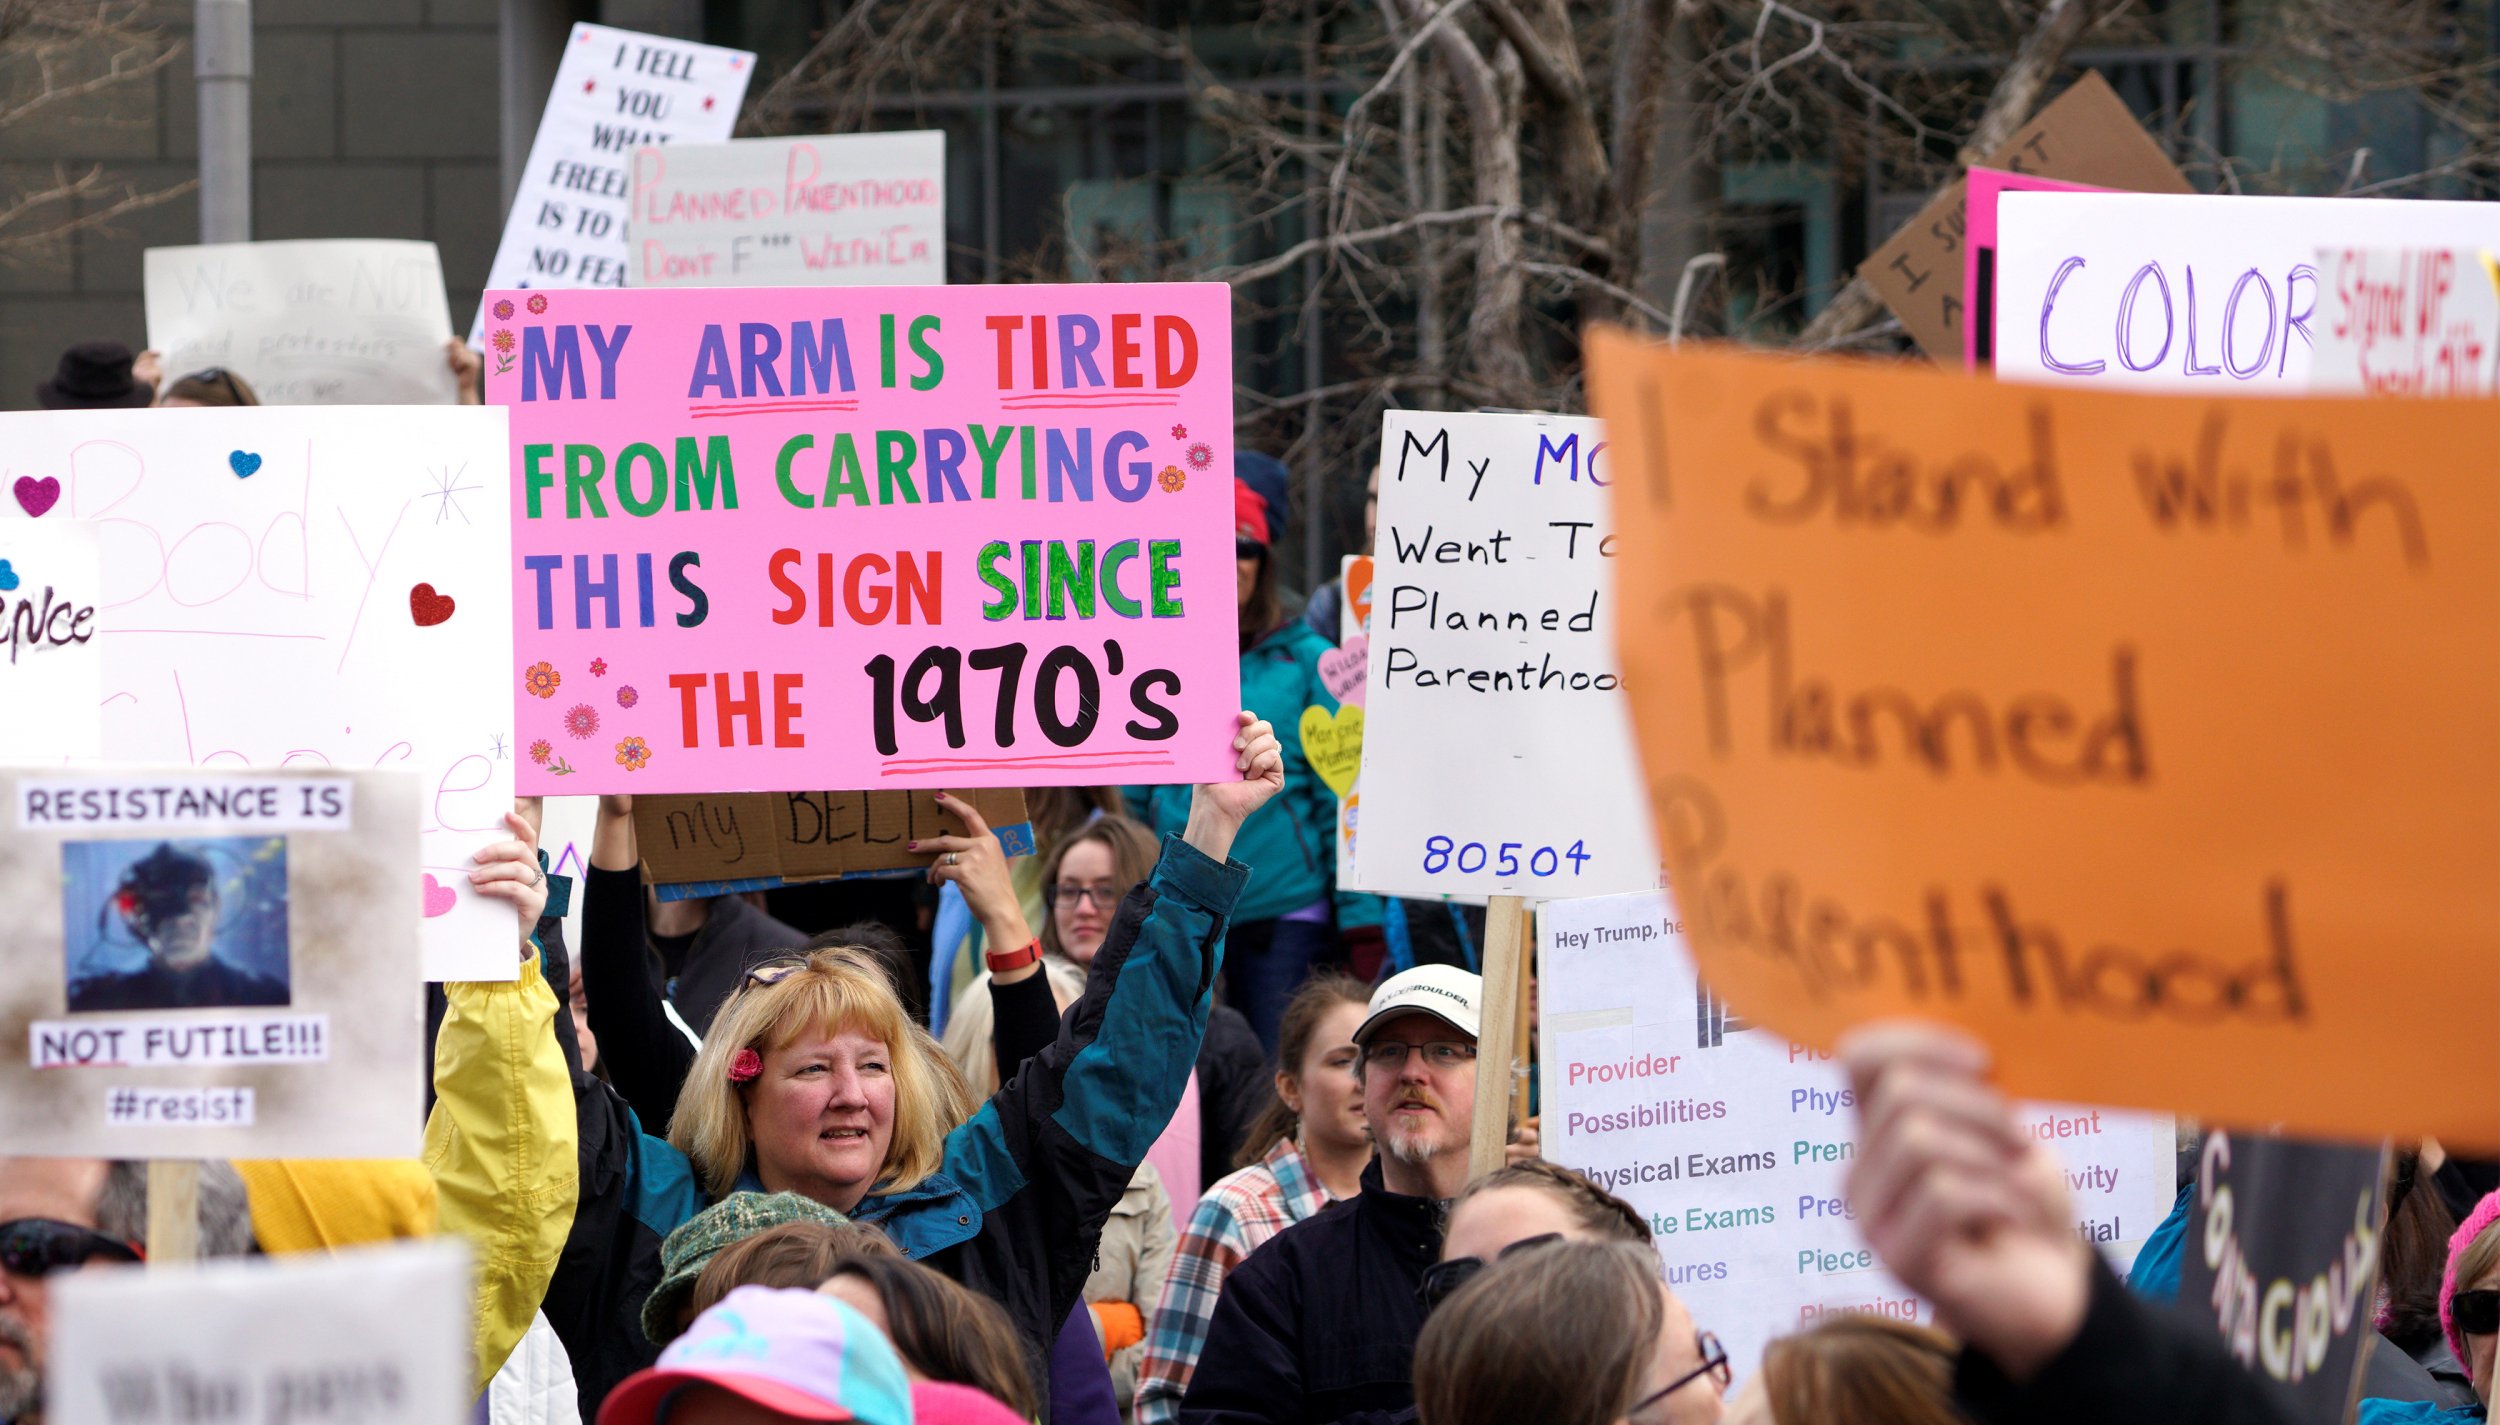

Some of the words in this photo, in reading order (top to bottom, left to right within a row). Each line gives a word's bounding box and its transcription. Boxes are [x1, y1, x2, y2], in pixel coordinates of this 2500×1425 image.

[613, 42, 627, 69] I
[634, 44, 697, 81] TELL
[615, 87, 672, 120] YOU
[536, 202, 565, 228] IS
[575, 207, 611, 237] TO
[527, 247, 570, 276] NO
[2040, 256, 2319, 379] COLOR
[520, 324, 633, 402] MY
[688, 317, 857, 399] ARM
[880, 313, 944, 392] IS
[985, 313, 1199, 390] TIRED
[523, 435, 739, 520] FROM
[776, 423, 1153, 509] CARRYING
[1397, 428, 1490, 501] My
[1742, 390, 2070, 536] Stand
[1391, 525, 1511, 565] Went
[525, 550, 709, 630] THIS
[768, 548, 943, 628] SIGN
[977, 539, 1184, 621] SINCE
[1390, 585, 1598, 632] Planned
[669, 671, 805, 749] THE
[864, 639, 1182, 756] 1970's
[1655, 580, 2156, 790] Planned
[26, 785, 279, 822] RESISTANCE
[299, 786, 343, 819] IS
[1423, 835, 1591, 877] 80504
[1650, 774, 2316, 1030] Parenthood
[1555, 931, 1590, 950] Hey
[1594, 923, 1658, 943] Trump,
[40, 1029, 127, 1063] NOT
[144, 1023, 322, 1060] FUTILE!!!
[1568, 1053, 1681, 1086] Provider
[107, 1088, 245, 1122] #resist
[1568, 1098, 1727, 1136] Possibilities
[1687, 1151, 1776, 1178] Exams
[1685, 1205, 1775, 1232] Exams
[1798, 1249, 1873, 1274] Piece
